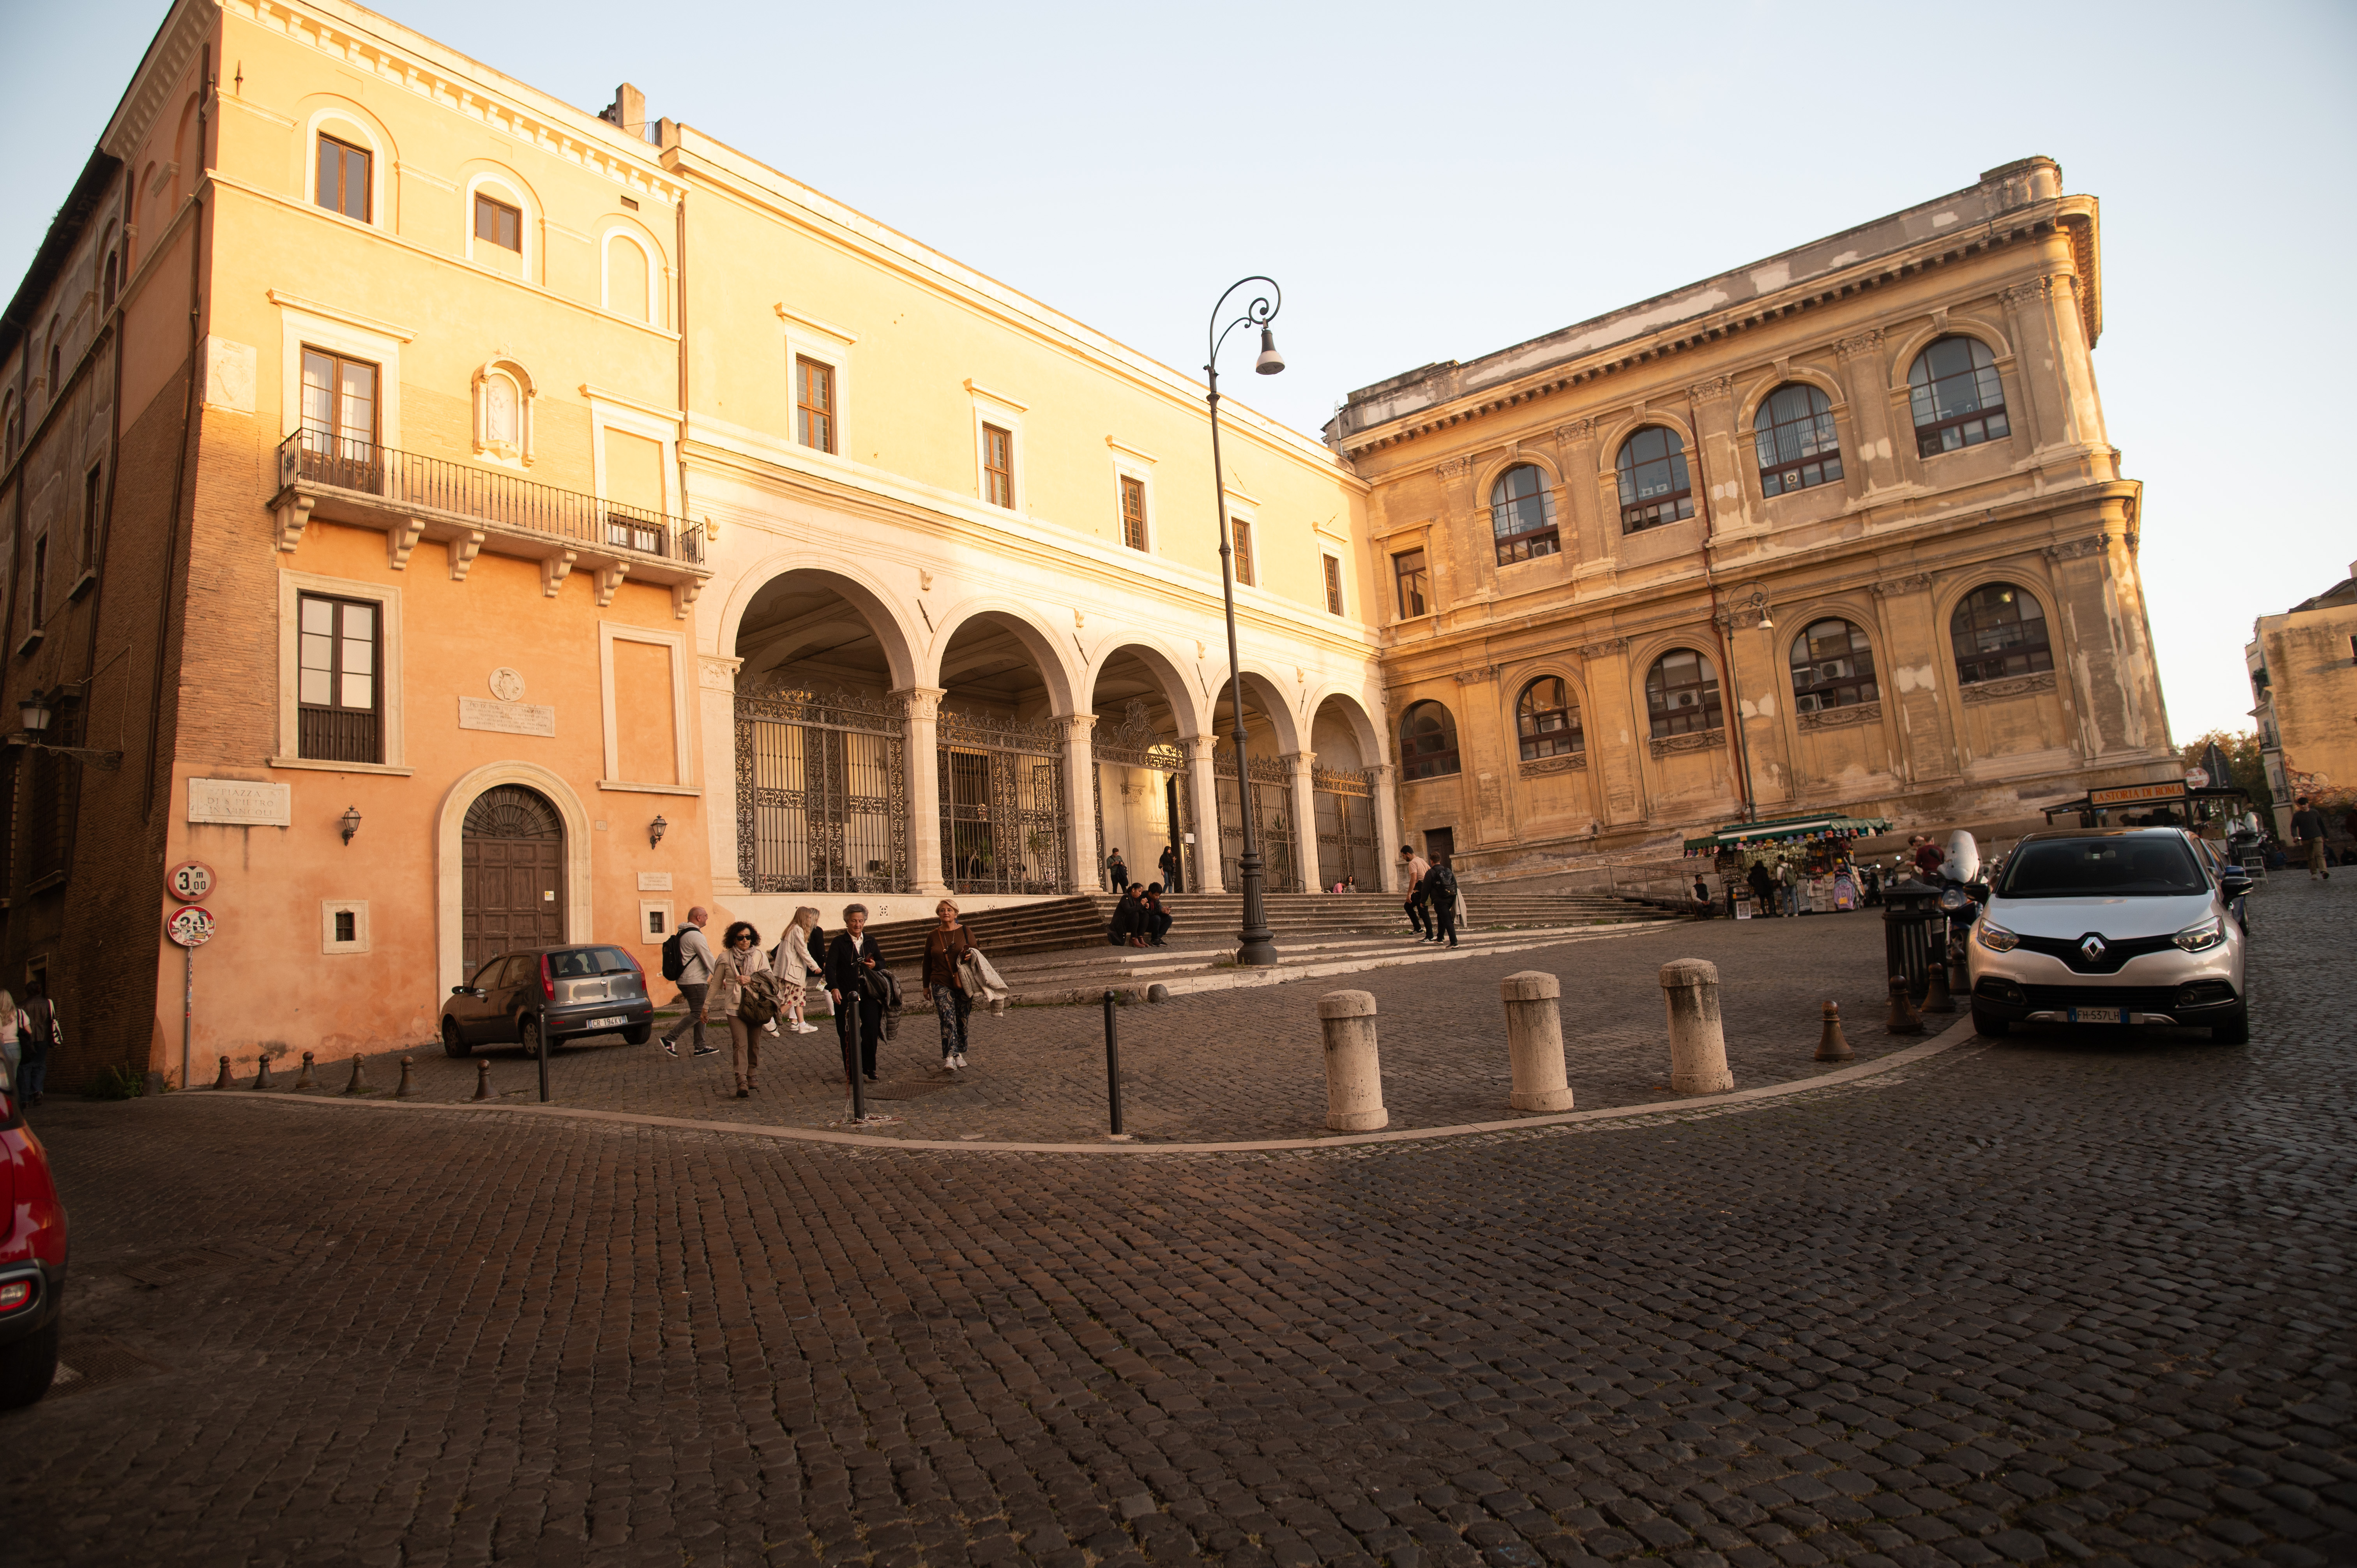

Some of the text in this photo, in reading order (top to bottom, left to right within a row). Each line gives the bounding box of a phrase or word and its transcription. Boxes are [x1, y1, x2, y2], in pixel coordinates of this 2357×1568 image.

[221, 788, 261, 797] PIAZZA
[2092, 784, 2183, 802] LA STORIA DI ROMA
[236, 799, 274, 807] PIETRO
[226, 807, 272, 816] VINCOLI
[2091, 1010, 2120, 1021] 537LH
[603, 1017, 622, 1026] 194KV
